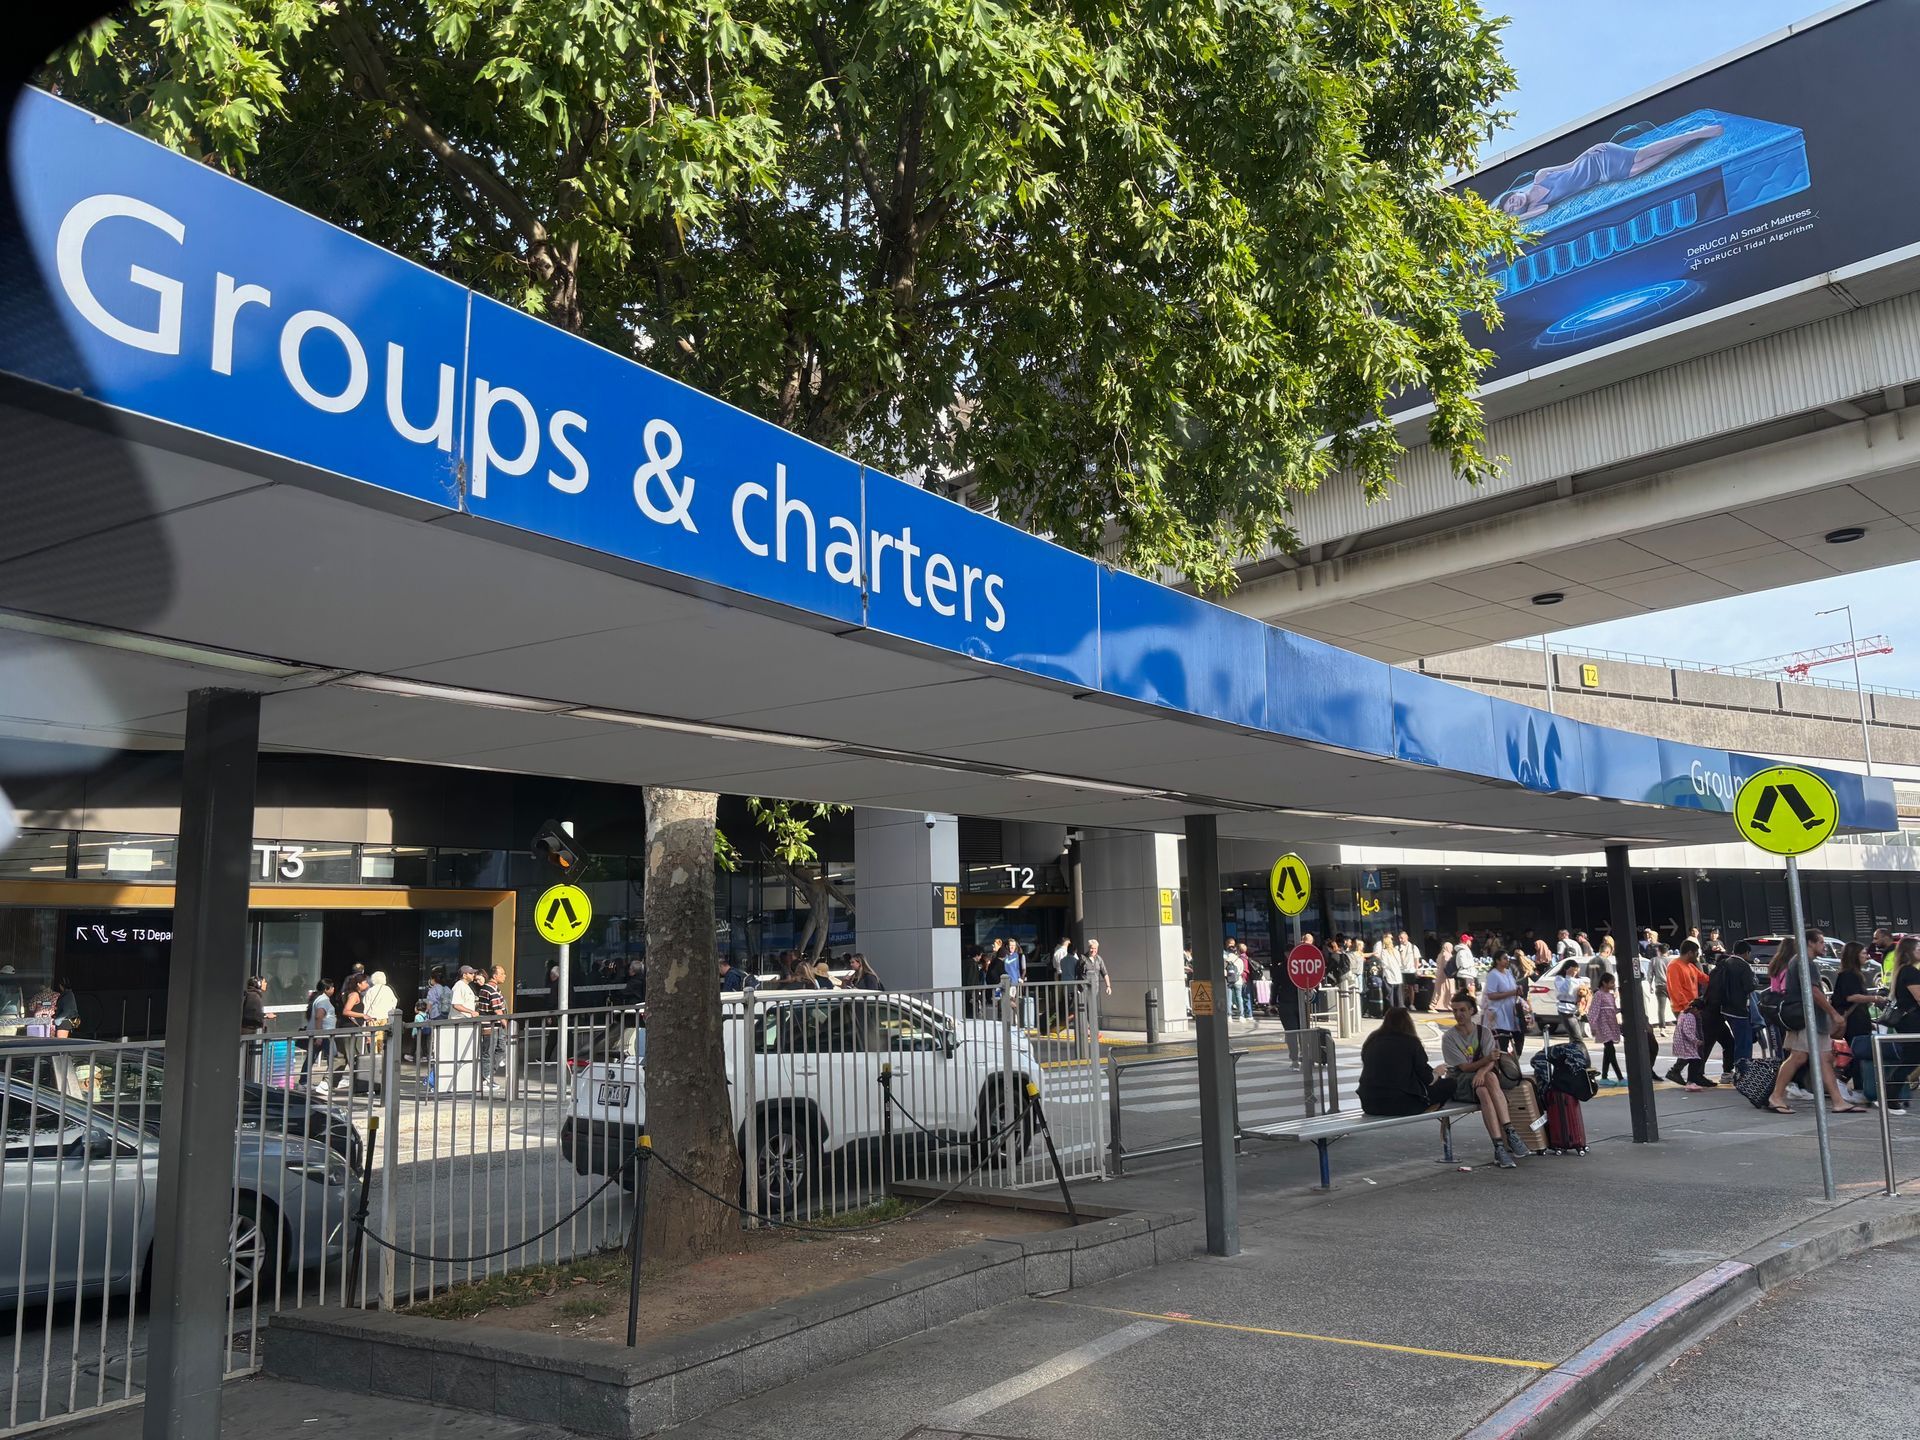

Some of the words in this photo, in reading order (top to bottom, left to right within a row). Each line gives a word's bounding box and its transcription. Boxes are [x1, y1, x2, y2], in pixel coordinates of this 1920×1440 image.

[1687, 237, 1727, 257] DeRUCCI
[1729, 232, 1739, 243] AI
[1741, 222, 1769, 237] Smart
[1771, 208, 1812, 228] Mattress
[1704, 247, 1742, 265] DeRUCCI
[1744, 239, 1766, 251] Tidal
[1769, 223, 1814, 243] Algorithm
[56, 193, 589, 499] Groups
[633, 418, 699, 534] &
[731, 462, 1006, 632] charters
[1585, 668, 1597, 682] T2
[253, 845, 304, 878] T3
[1005, 867, 1035, 889] T2
[1366, 873, 1377, 888] A
[945, 890, 956, 900] T3
[1162, 893, 1170, 902] T1
[945, 911, 956, 921] T4
[1163, 911, 1171, 920] T2
[1896, 916, 1908, 926] Uber
[1728, 920, 1742, 929] Uber
[132, 928, 146, 940] T3
[1291, 959, 1322, 975] STOP
